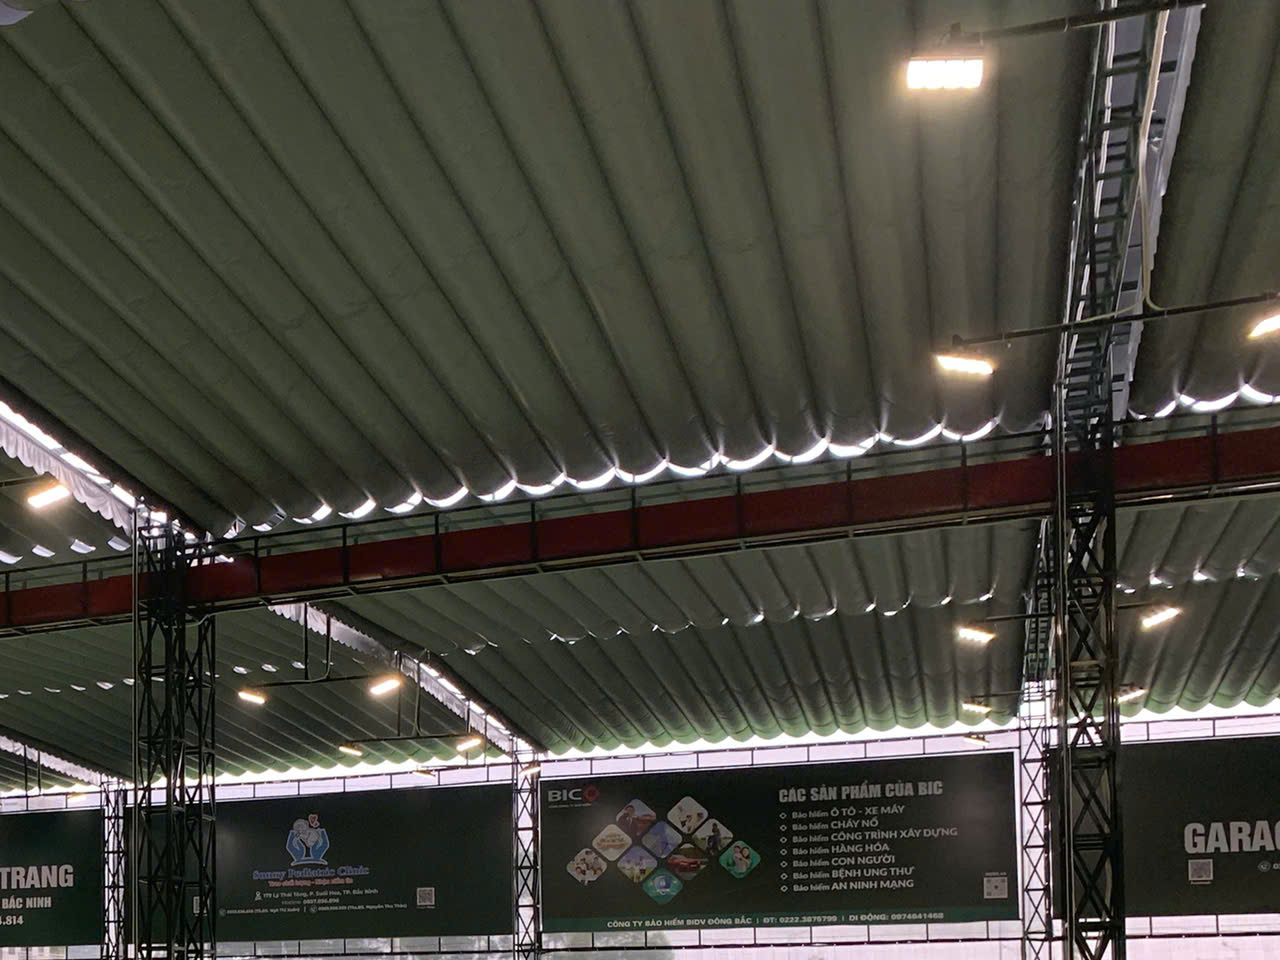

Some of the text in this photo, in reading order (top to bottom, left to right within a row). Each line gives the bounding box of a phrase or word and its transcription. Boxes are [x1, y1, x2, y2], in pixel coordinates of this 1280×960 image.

[548, 788, 583, 802] BIC
[779, 780, 944, 803] CÁC SẢN PHẨM CỦA BIC
[830, 807, 840, 817] Ô
[842, 806, 857, 816] TÔ
[865, 806, 879, 815] XE
[880, 803, 905, 815] MÁY
[830, 818, 860, 830] CHÁY
[831, 830, 863, 842] CÔNG
[864, 828, 897, 840] TRÌNH
[923, 827, 958, 838] DỰNG
[1184, 820, 1280, 854] GARA
[831, 843, 863, 854] HÀNG
[865, 842, 890, 852] HÓA
[831, 857, 856, 866] CON
[857, 854, 896, 865] NGƯỜI
[337, 865, 370, 876] Clinic
[832, 866, 862, 879] BỆNH
[863, 867, 888, 877] UNG
[889, 866, 915, 876] THƯ
[831, 881, 848, 891] AN
[849, 880, 878, 890] NINH
[880, 879, 914, 890] MẠNG
[1, 895, 23, 910] BẮC
[25, 896, 52, 909] NINH
[607, 919, 631, 928] CÔNG
[686, 918, 706, 926] BIDV
[849, 914, 859, 922] DI
